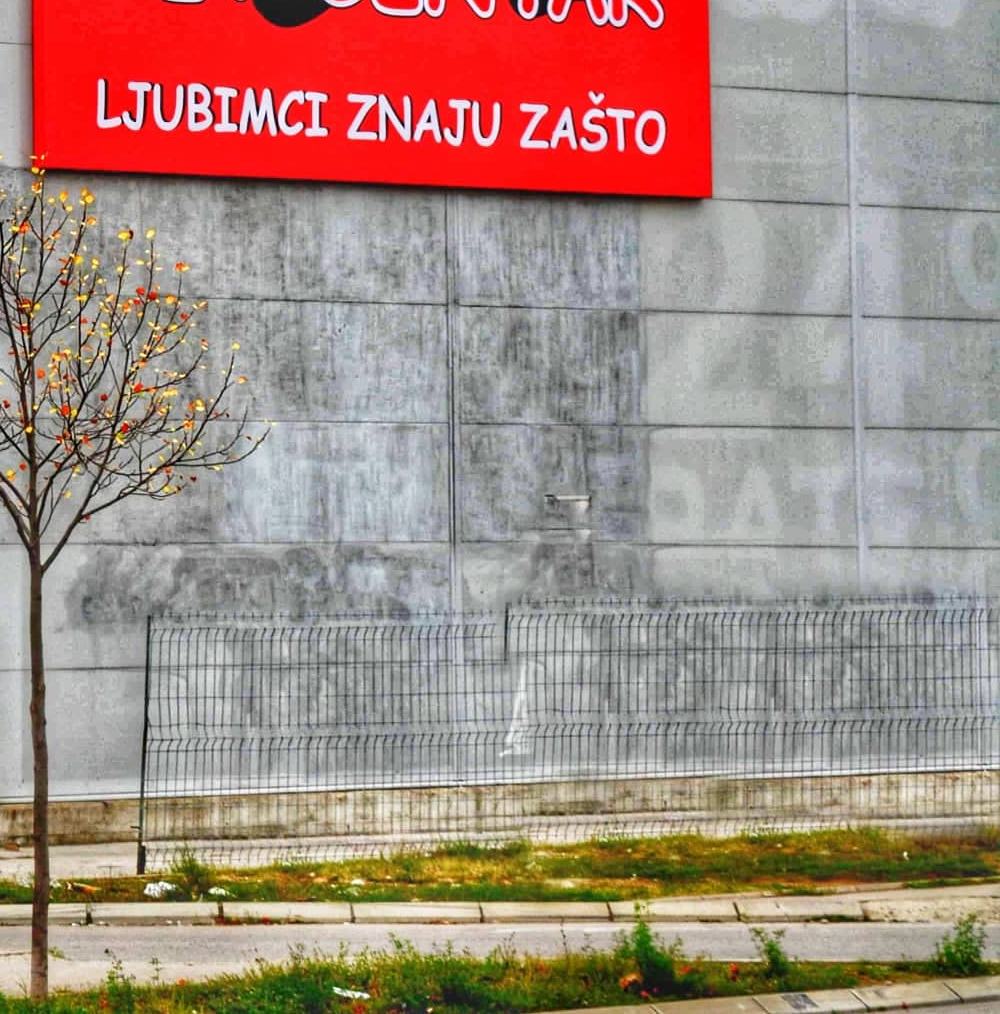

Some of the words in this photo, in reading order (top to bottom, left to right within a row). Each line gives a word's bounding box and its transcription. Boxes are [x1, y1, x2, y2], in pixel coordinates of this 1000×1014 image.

[97, 79, 328, 136] LJUBIMCI
[347, 94, 500, 146] ZNAJU
[520, 91, 665, 154] ZAŠTO
